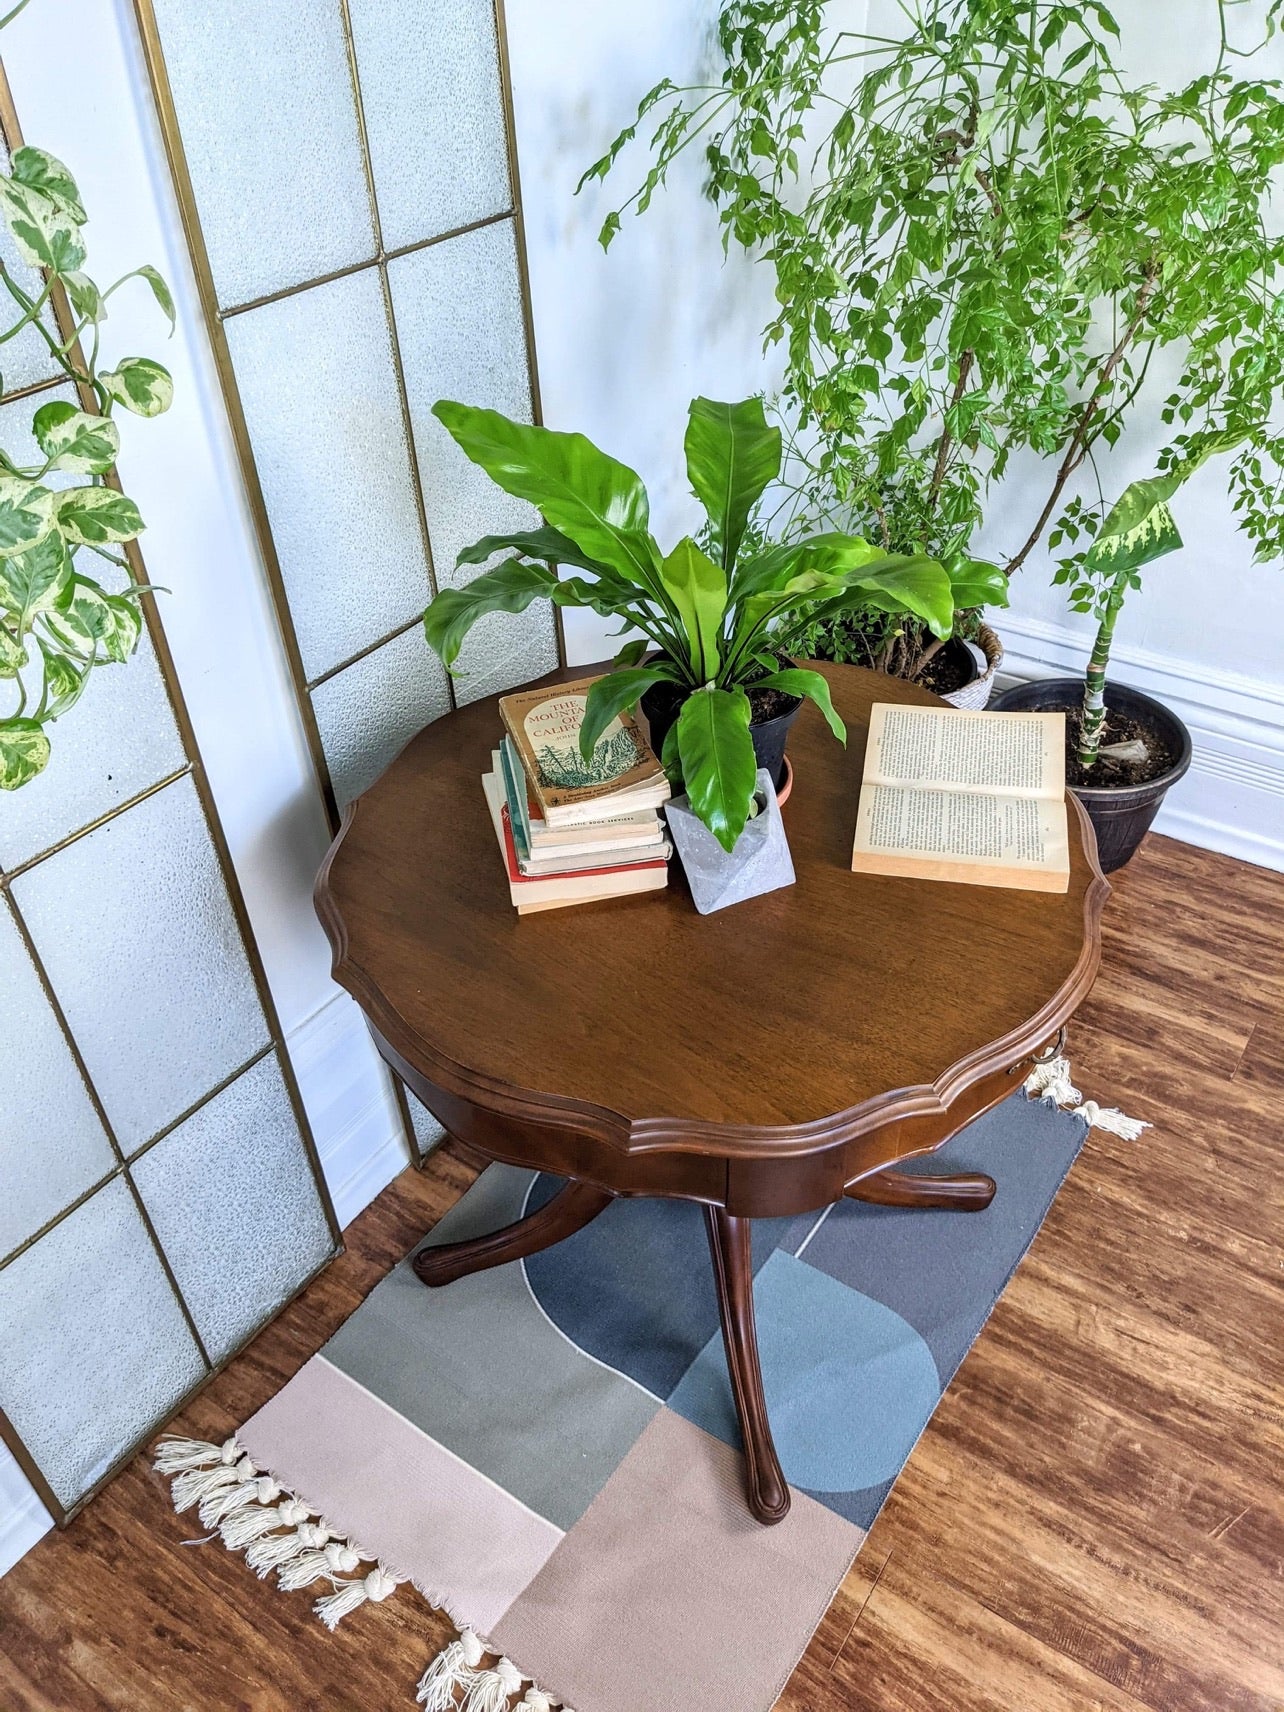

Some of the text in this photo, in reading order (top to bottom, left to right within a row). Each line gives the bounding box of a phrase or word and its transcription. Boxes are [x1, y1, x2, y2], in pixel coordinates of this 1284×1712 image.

[550, 700, 578, 710] THE
[528, 708, 585, 723] MOUNTA
[562, 715, 578, 724] OF
[533, 722, 582, 738] CALIFO
